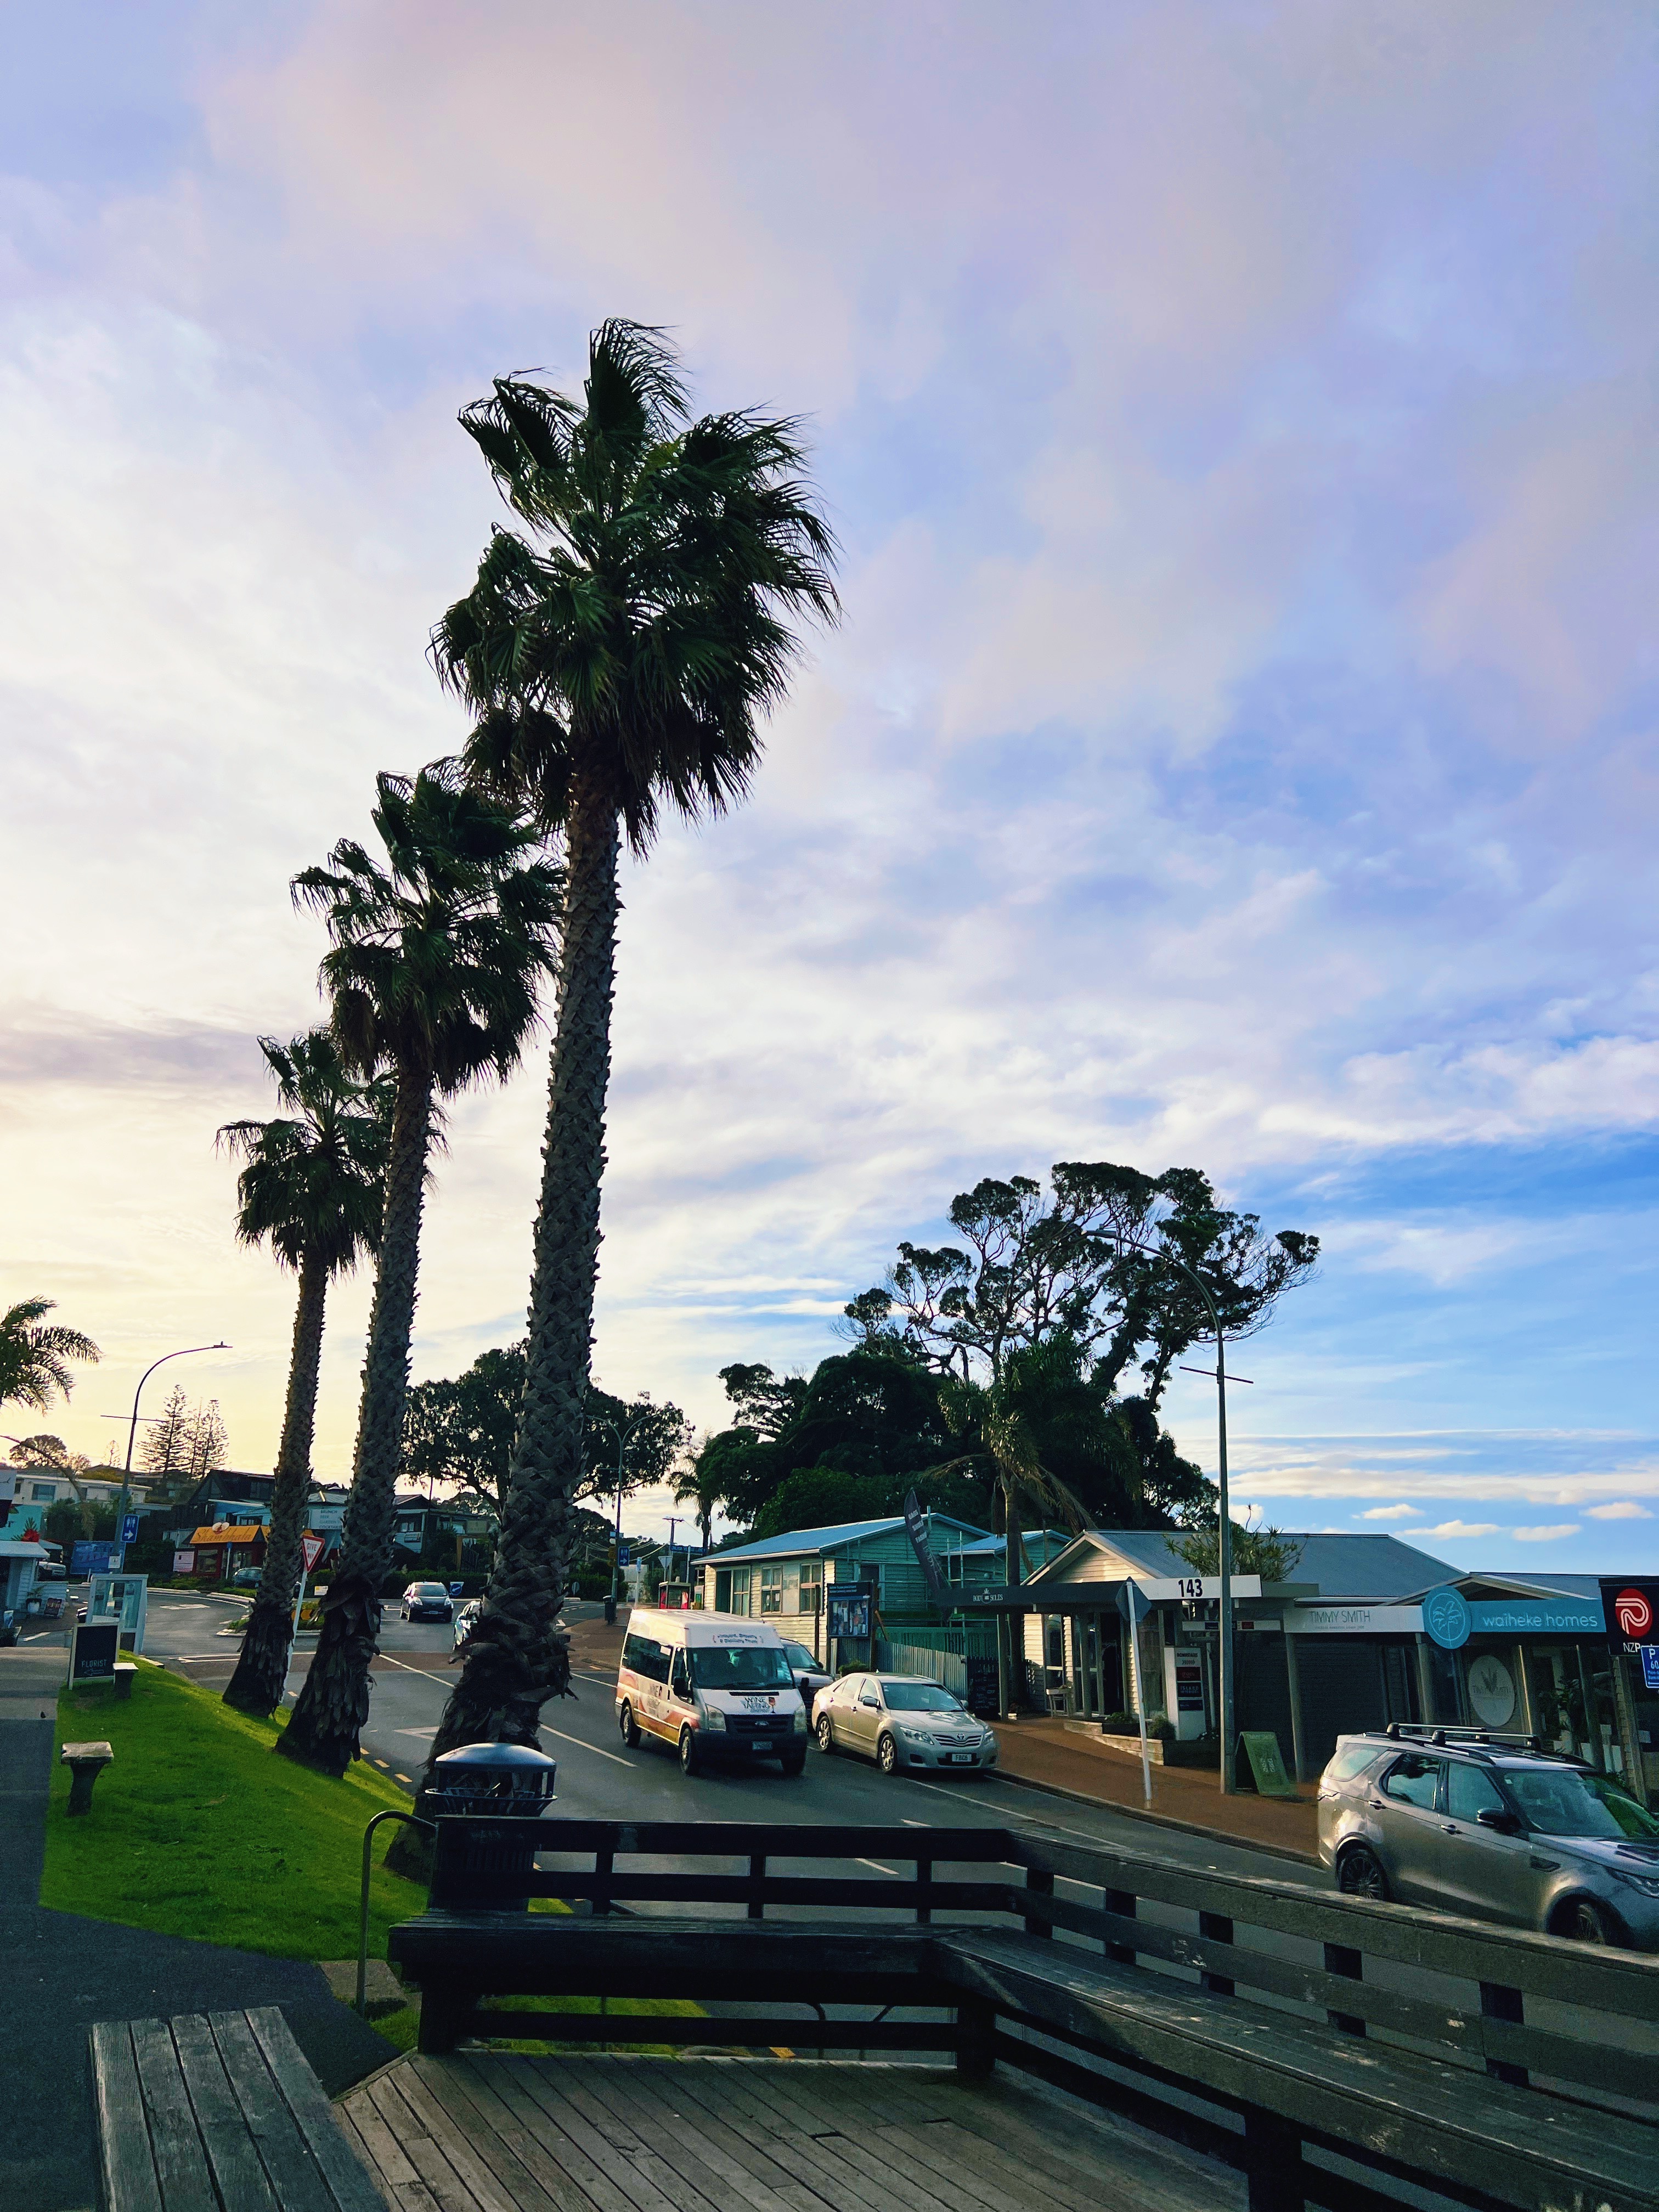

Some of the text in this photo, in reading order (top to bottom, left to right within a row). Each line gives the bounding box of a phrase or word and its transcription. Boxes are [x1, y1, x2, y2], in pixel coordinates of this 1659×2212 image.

[307, 1542, 317, 1551] GIVE
[1178, 1578, 1203, 1598] 143
[1308, 1610, 1371, 1623] TIMMY SMITH
[1482, 1612, 1598, 1627] waiheke homes
[1623, 1642, 1641, 1653] NZP
[1649, 1648, 1656, 1660] P
[81, 1659, 107, 1668] FLORIST
